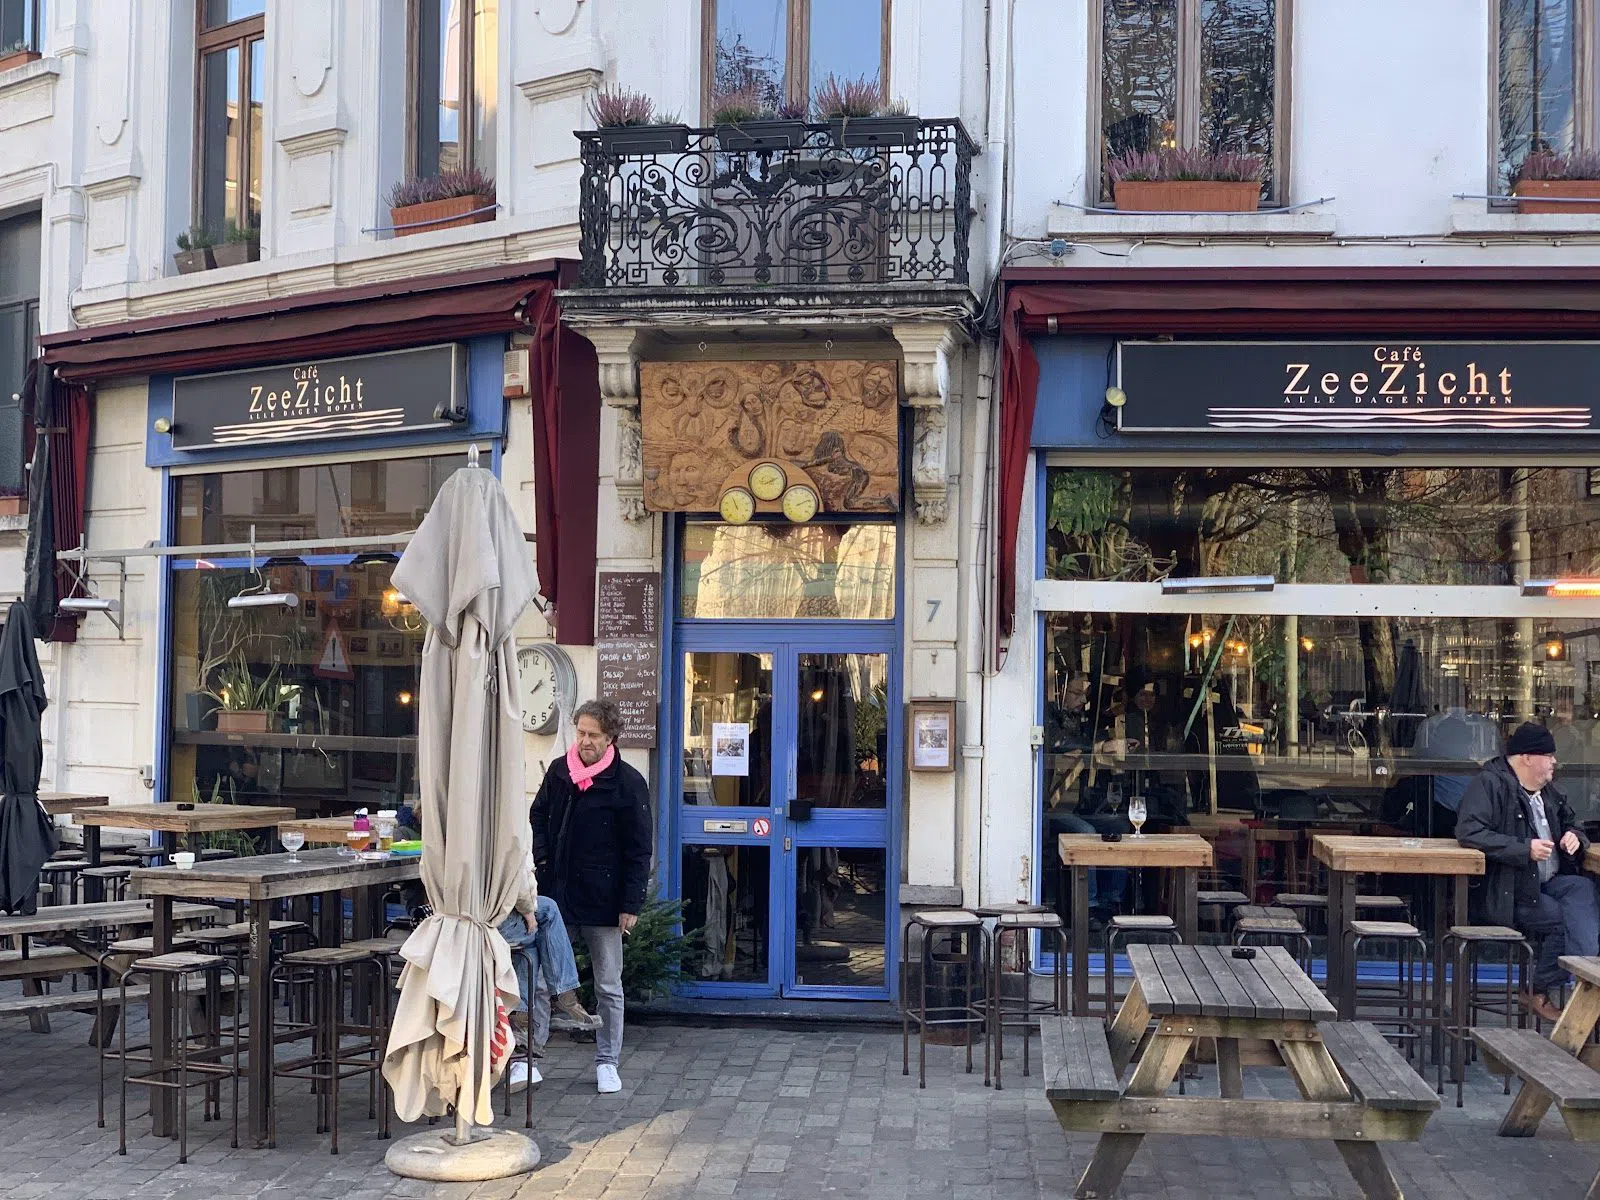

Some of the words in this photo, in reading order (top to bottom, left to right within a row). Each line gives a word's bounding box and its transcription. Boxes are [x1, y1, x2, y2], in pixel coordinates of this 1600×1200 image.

[1373, 346, 1423, 362] Café
[293, 366, 318, 380] Café
[1283, 362, 1513, 396] ZeeZicht
[249, 375, 363, 412] ZeeZicht
[1283, 396, 1336, 404] ALLE
[1354, 396, 1424, 404] DAGEN
[1443, 396, 1513, 404] HOPEN
[248, 411, 276, 421] ALLE
[283, 406, 319, 417] DAGEN
[327, 402, 364, 413] HOPEN
[926, 600, 942, 623] 7
[523, 659, 529, 669] 11
[533, 655, 539, 666] 12
[550, 672, 555, 682] 2
[548, 702, 554, 710] 4
[522, 710, 527, 719] 7
[541, 712, 547, 722] 5
[530, 715, 537, 725] 6
